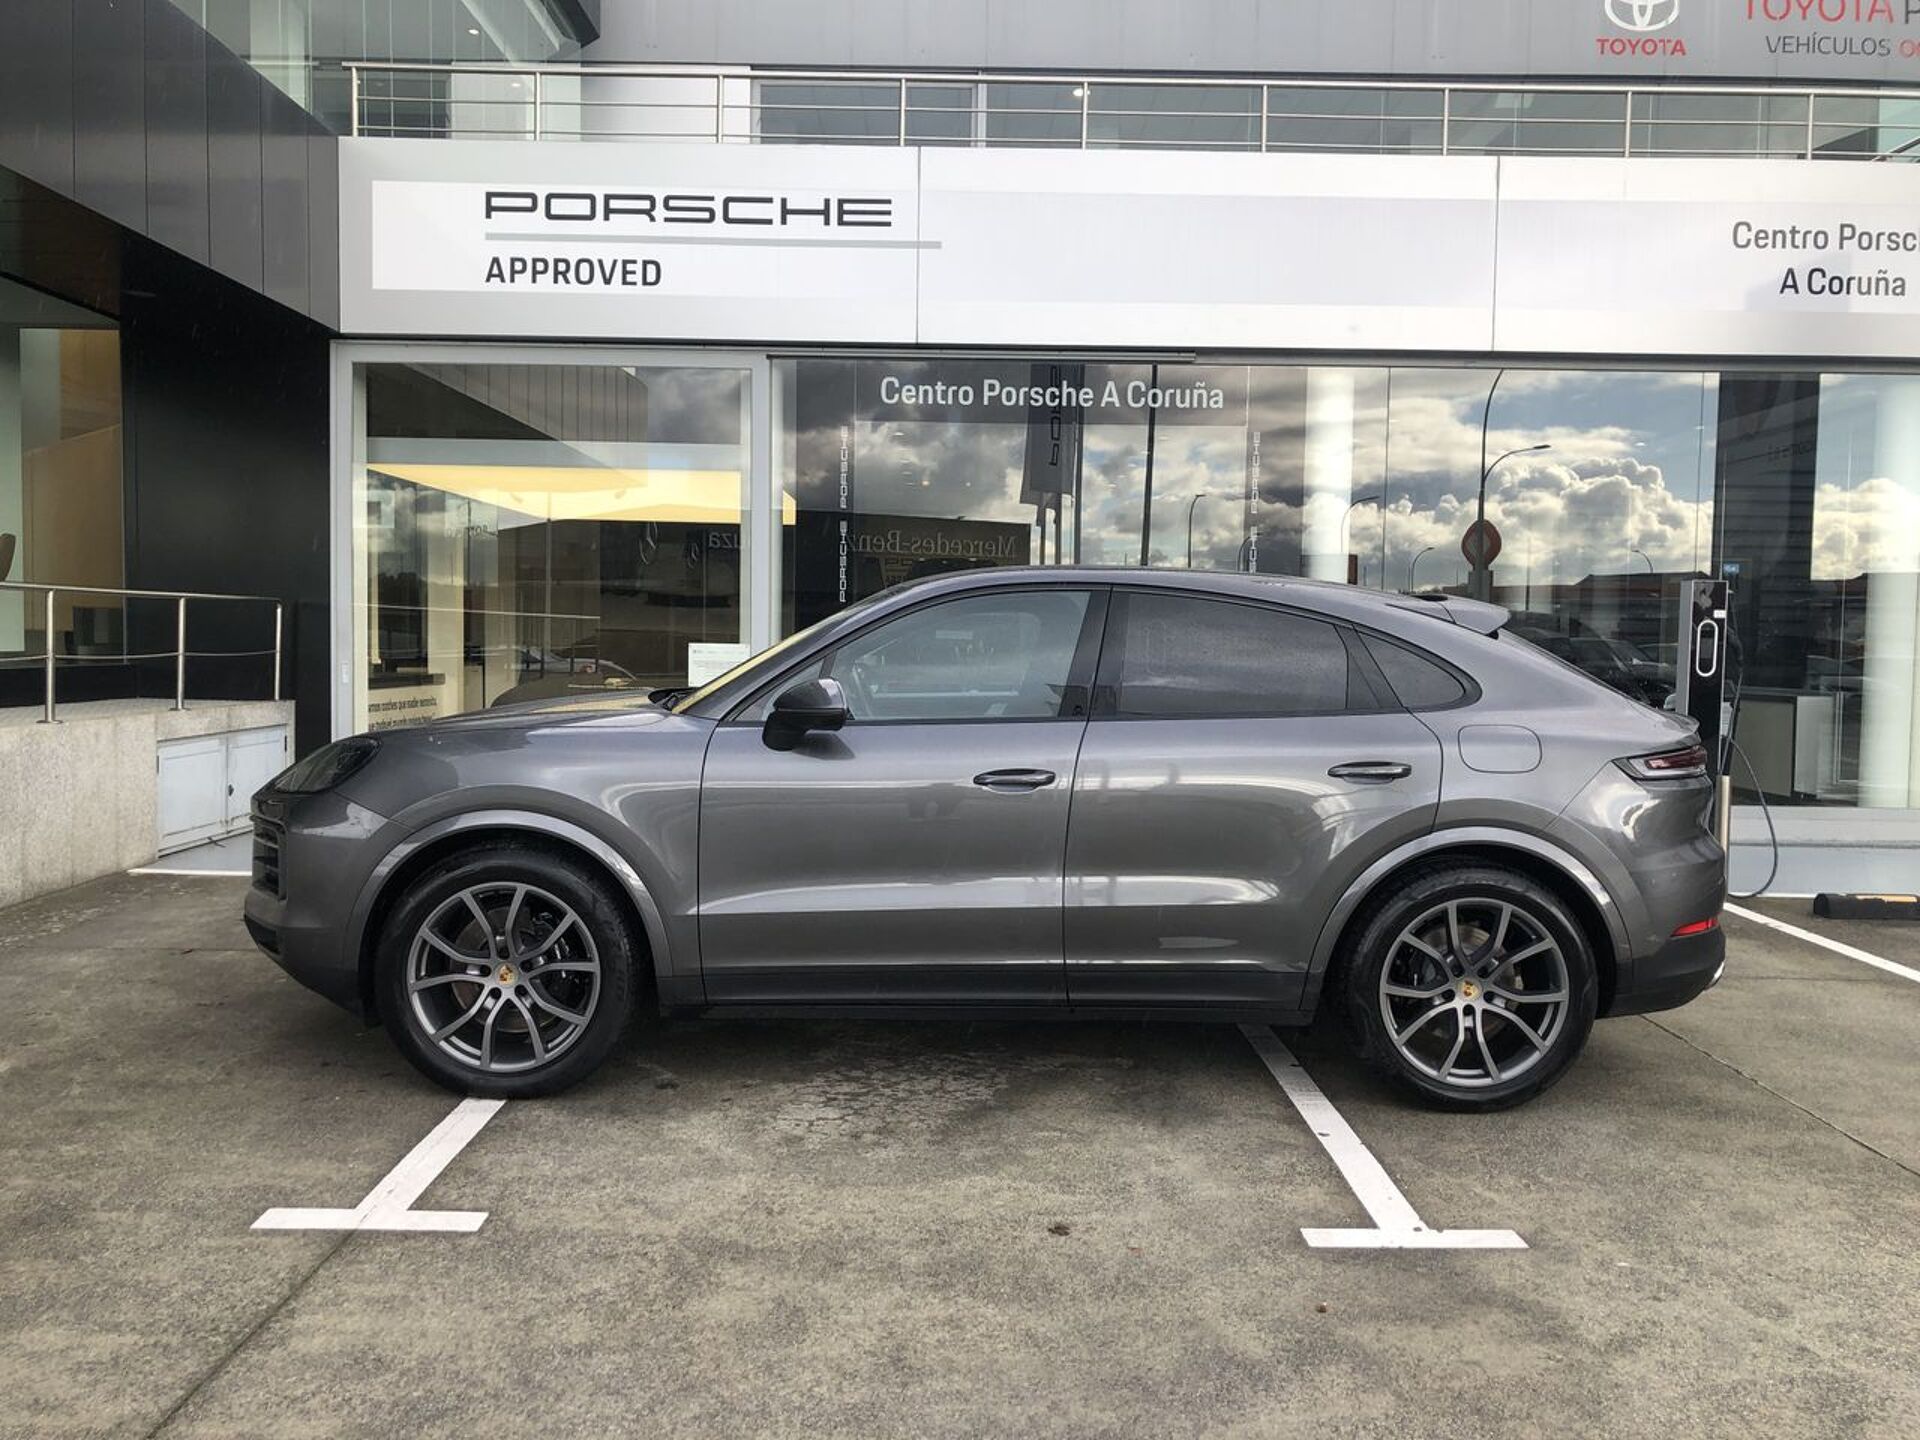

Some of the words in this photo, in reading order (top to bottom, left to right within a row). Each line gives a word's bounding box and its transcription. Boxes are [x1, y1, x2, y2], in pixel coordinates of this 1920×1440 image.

[1596, 38, 1687, 56] TOYOTA
[1766, 32, 1891, 57] VEHÍCULOS
[485, 191, 892, 227] PORSCHE
[1733, 221, 1829, 250] Centro
[1838, 223, 1920, 251] Porsc
[485, 256, 662, 287] APPROVED
[1779, 267, 1800, 294] A
[1807, 268, 1906, 297] Coruña
[880, 376, 974, 406] Centro
[983, 379, 1094, 408] Porsche
[1100, 380, 1120, 408] A
[1127, 380, 1224, 409] Coruña
[840, 425, 849, 510] PORSCHE
[839, 520, 848, 603] PORSCHE
